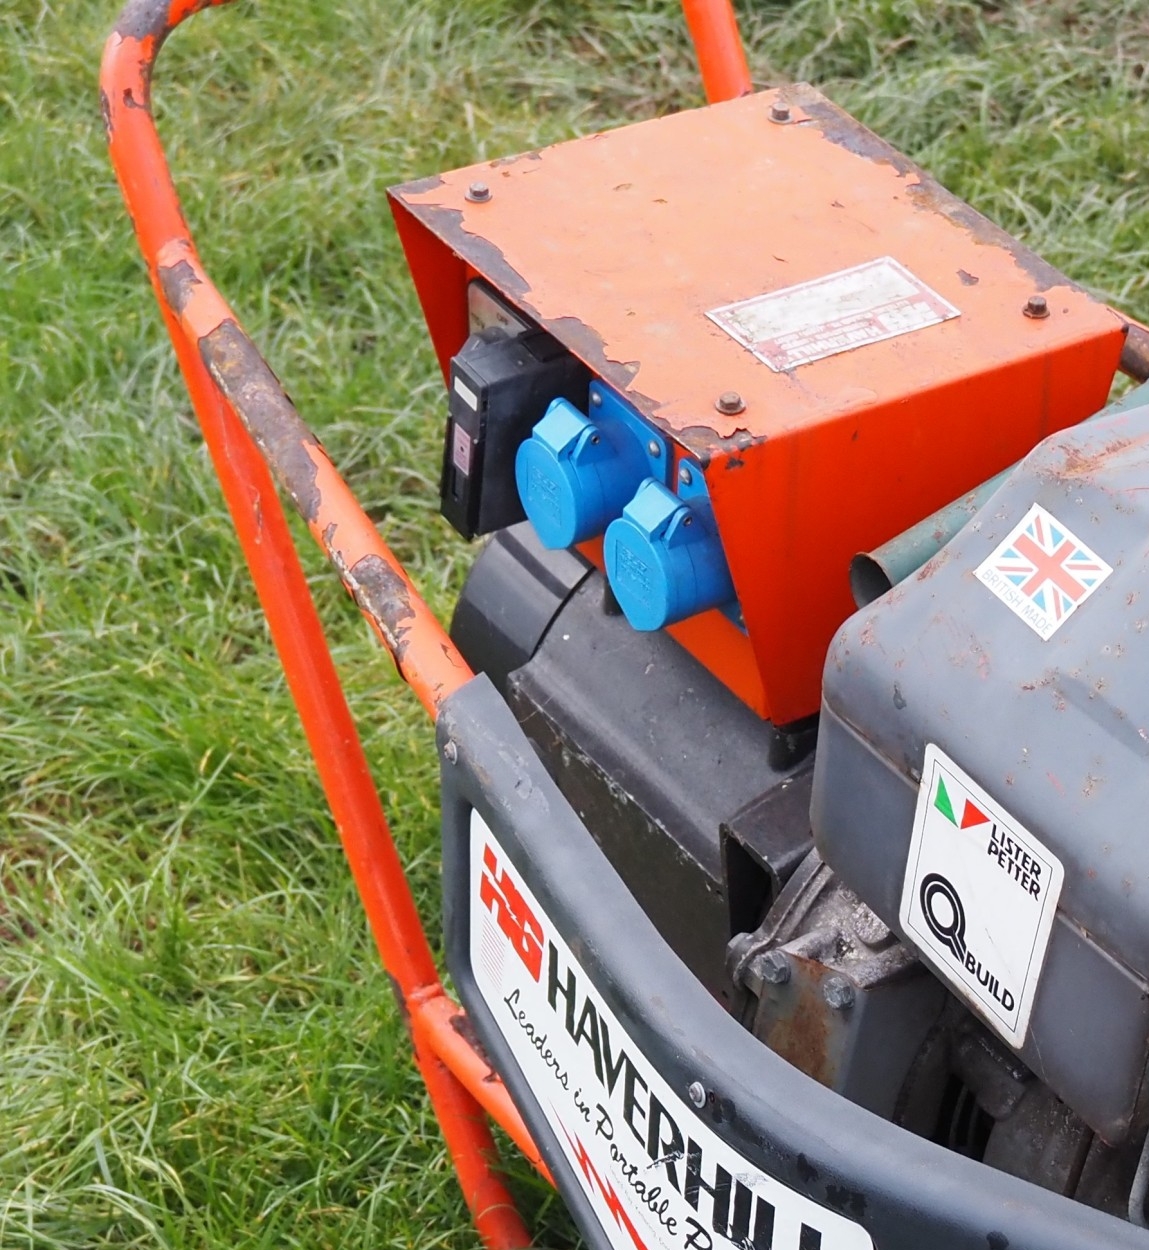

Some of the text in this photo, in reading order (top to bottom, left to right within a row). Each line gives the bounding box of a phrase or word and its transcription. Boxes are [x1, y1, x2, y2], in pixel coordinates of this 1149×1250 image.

[981, 568, 1053, 635] BRITISH MADE
[987, 841, 1041, 902] PETTER
[989, 823, 1042, 882] LISTER
[503, 987, 569, 1091] Leaders
[573, 1087, 590, 1122] in
[594, 1102, 677, 1237] Portable
